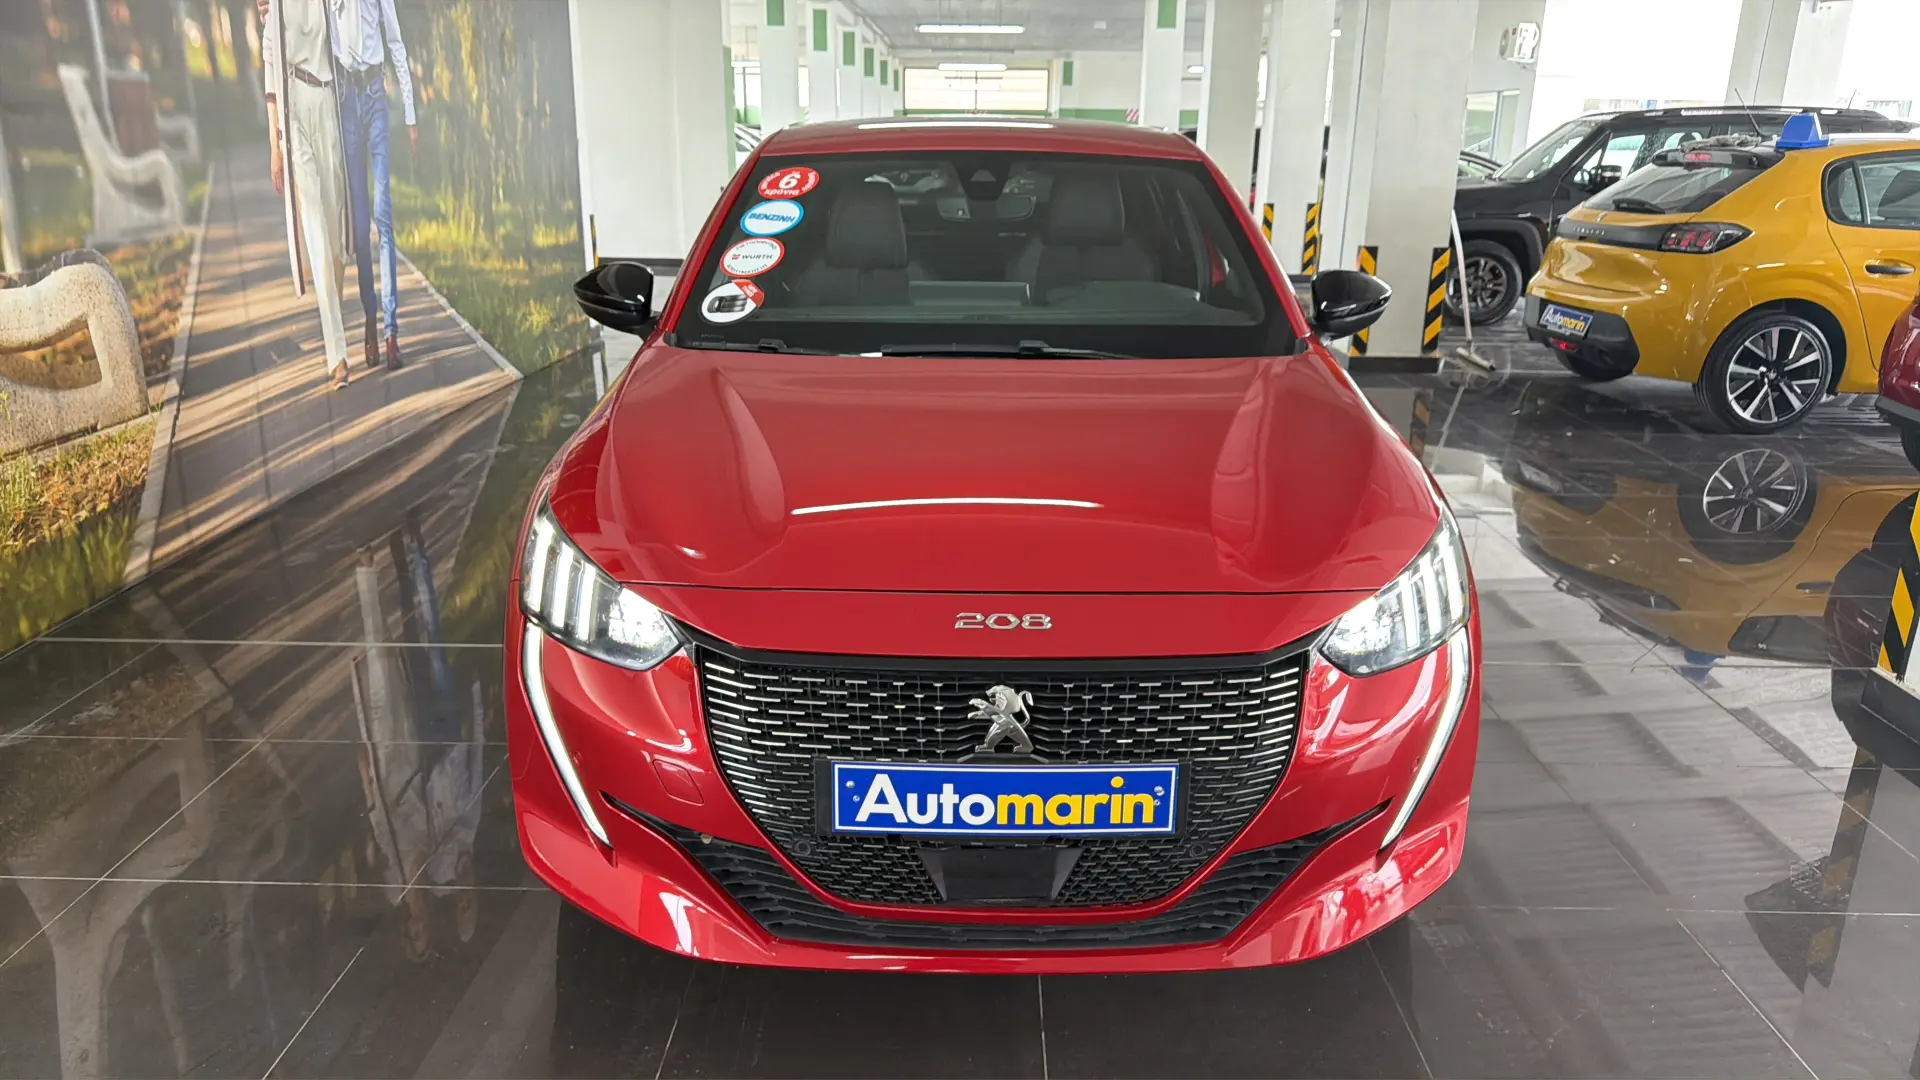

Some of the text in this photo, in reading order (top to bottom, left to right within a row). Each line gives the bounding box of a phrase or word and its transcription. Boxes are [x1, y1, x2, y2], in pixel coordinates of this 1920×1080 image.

[778, 172, 801, 189] 6
[1543, 307, 1586, 332] Automarin
[954, 611, 1053, 630] 208
[854, 773, 1155, 826] Automarin
